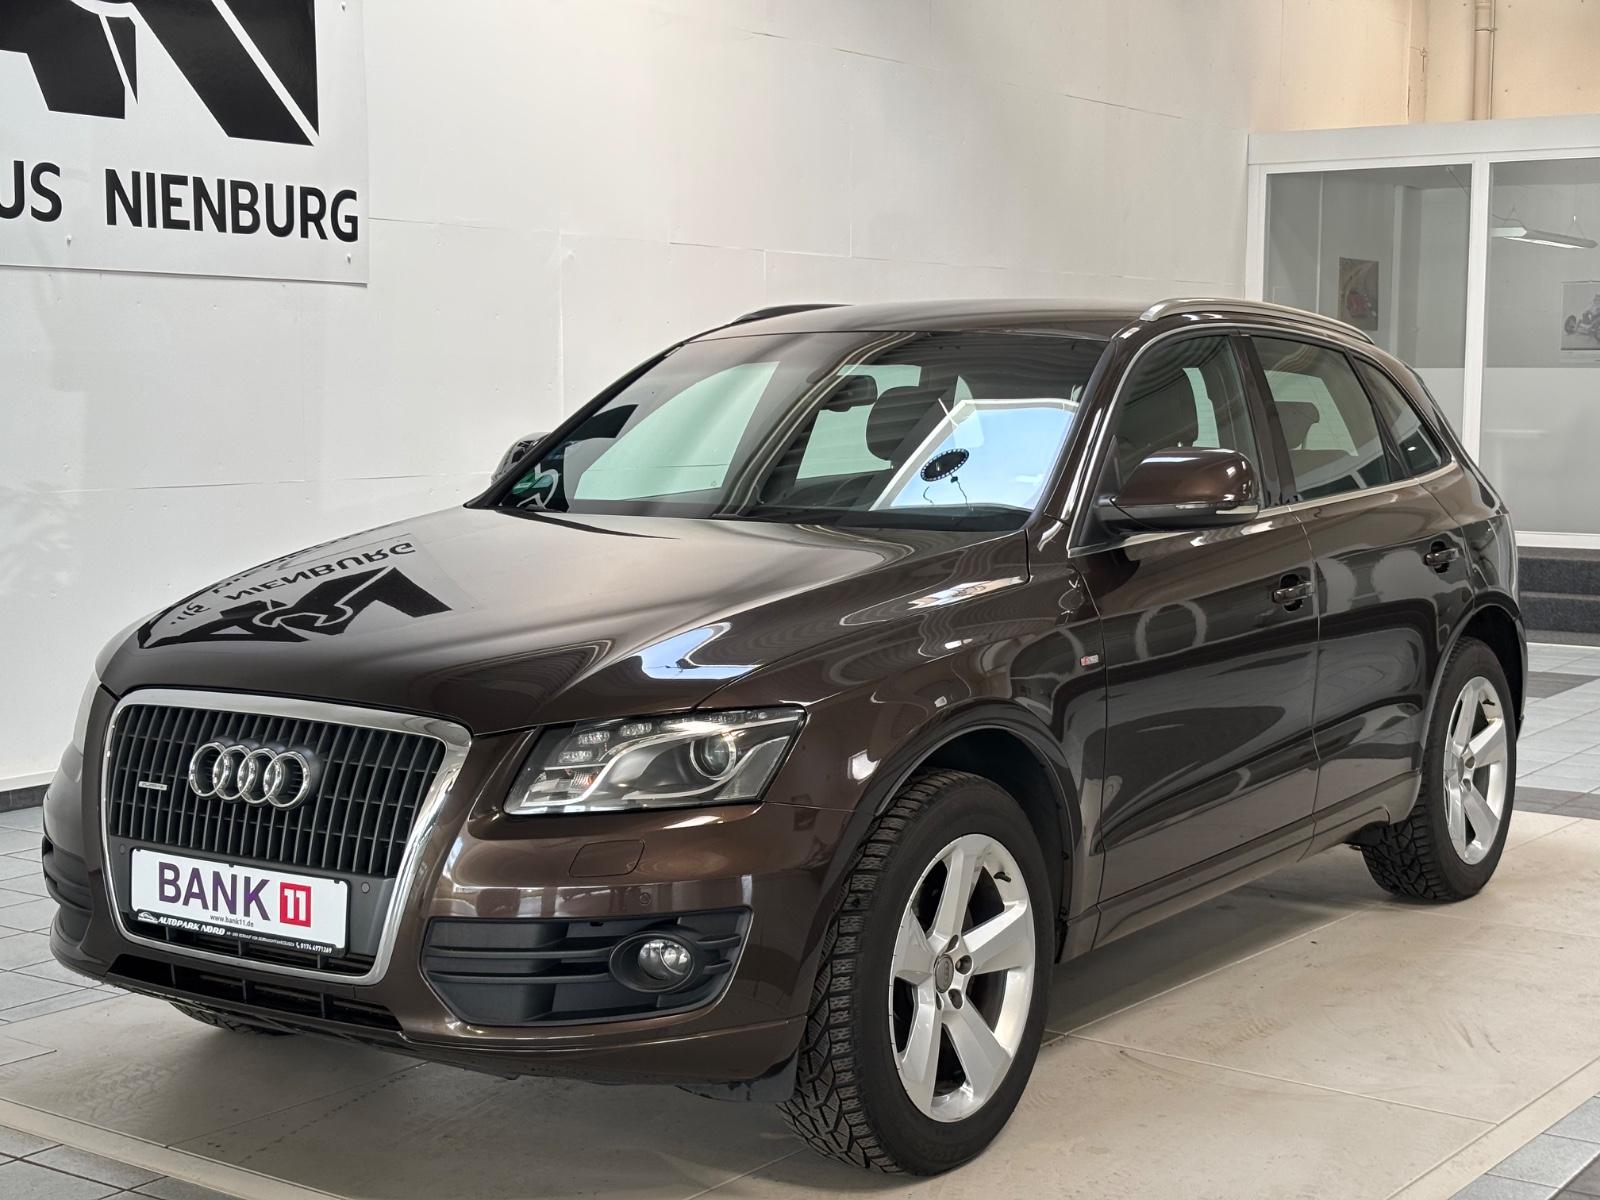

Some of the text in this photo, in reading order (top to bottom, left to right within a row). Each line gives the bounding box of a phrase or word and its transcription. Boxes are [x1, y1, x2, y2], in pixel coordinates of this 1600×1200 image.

[104, 168, 360, 243] NIENBURG
[158, 860, 307, 922] BANK 11
[158, 916, 201, 931] AUTOPARK
[201, 924, 226, 936] NORD
[210, 914, 254, 928] www.bank11.de
